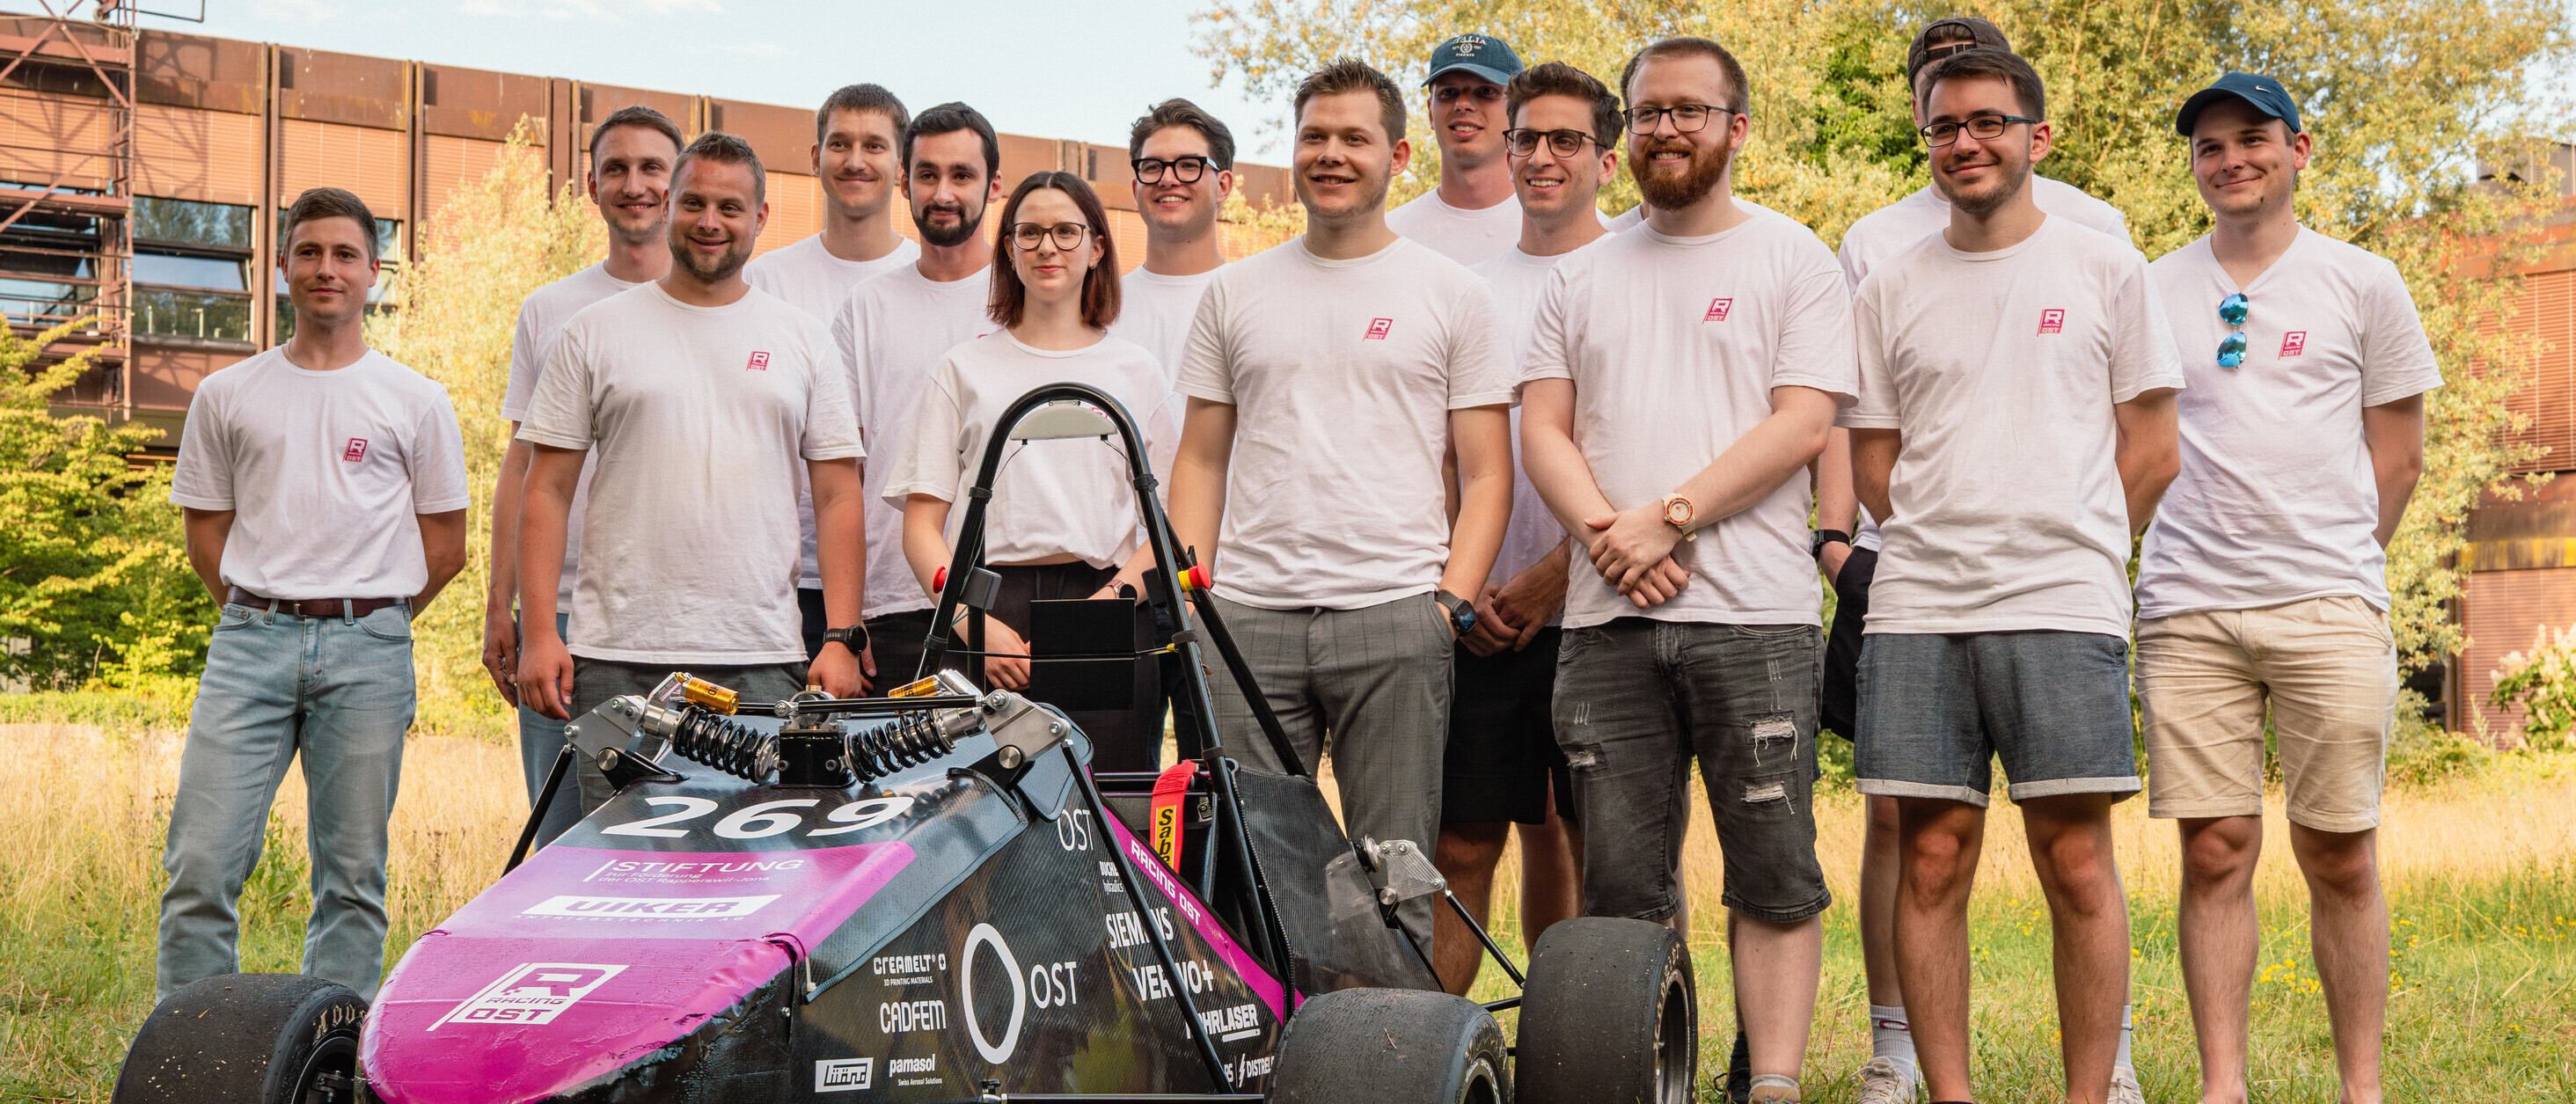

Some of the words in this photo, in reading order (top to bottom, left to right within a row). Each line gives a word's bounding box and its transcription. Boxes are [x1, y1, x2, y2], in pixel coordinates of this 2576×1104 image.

[600, 796, 915, 839] 269
[1057, 808, 1094, 852] OST
[611, 859, 804, 873] STIFTUNG
[1131, 838, 1176, 899] RACING
[1179, 892, 1201, 925] OST
[510, 915, 706, 924] ANTRIEBSTECHNIK
[565, 901, 740, 914] UIKER
[1106, 907, 1174, 949] SIEMNS
[890, 977, 911, 986] PRINTING
[911, 976, 933, 984] MATERIALS
[1030, 961, 1077, 1009] OST
[465, 1008, 553, 1021] OST
[486, 997, 567, 1005] RACING
[880, 999, 947, 1034] CADFEM
[1185, 1004, 1259, 1040] HRLASER
[889, 1054, 936, 1078] pamasol
